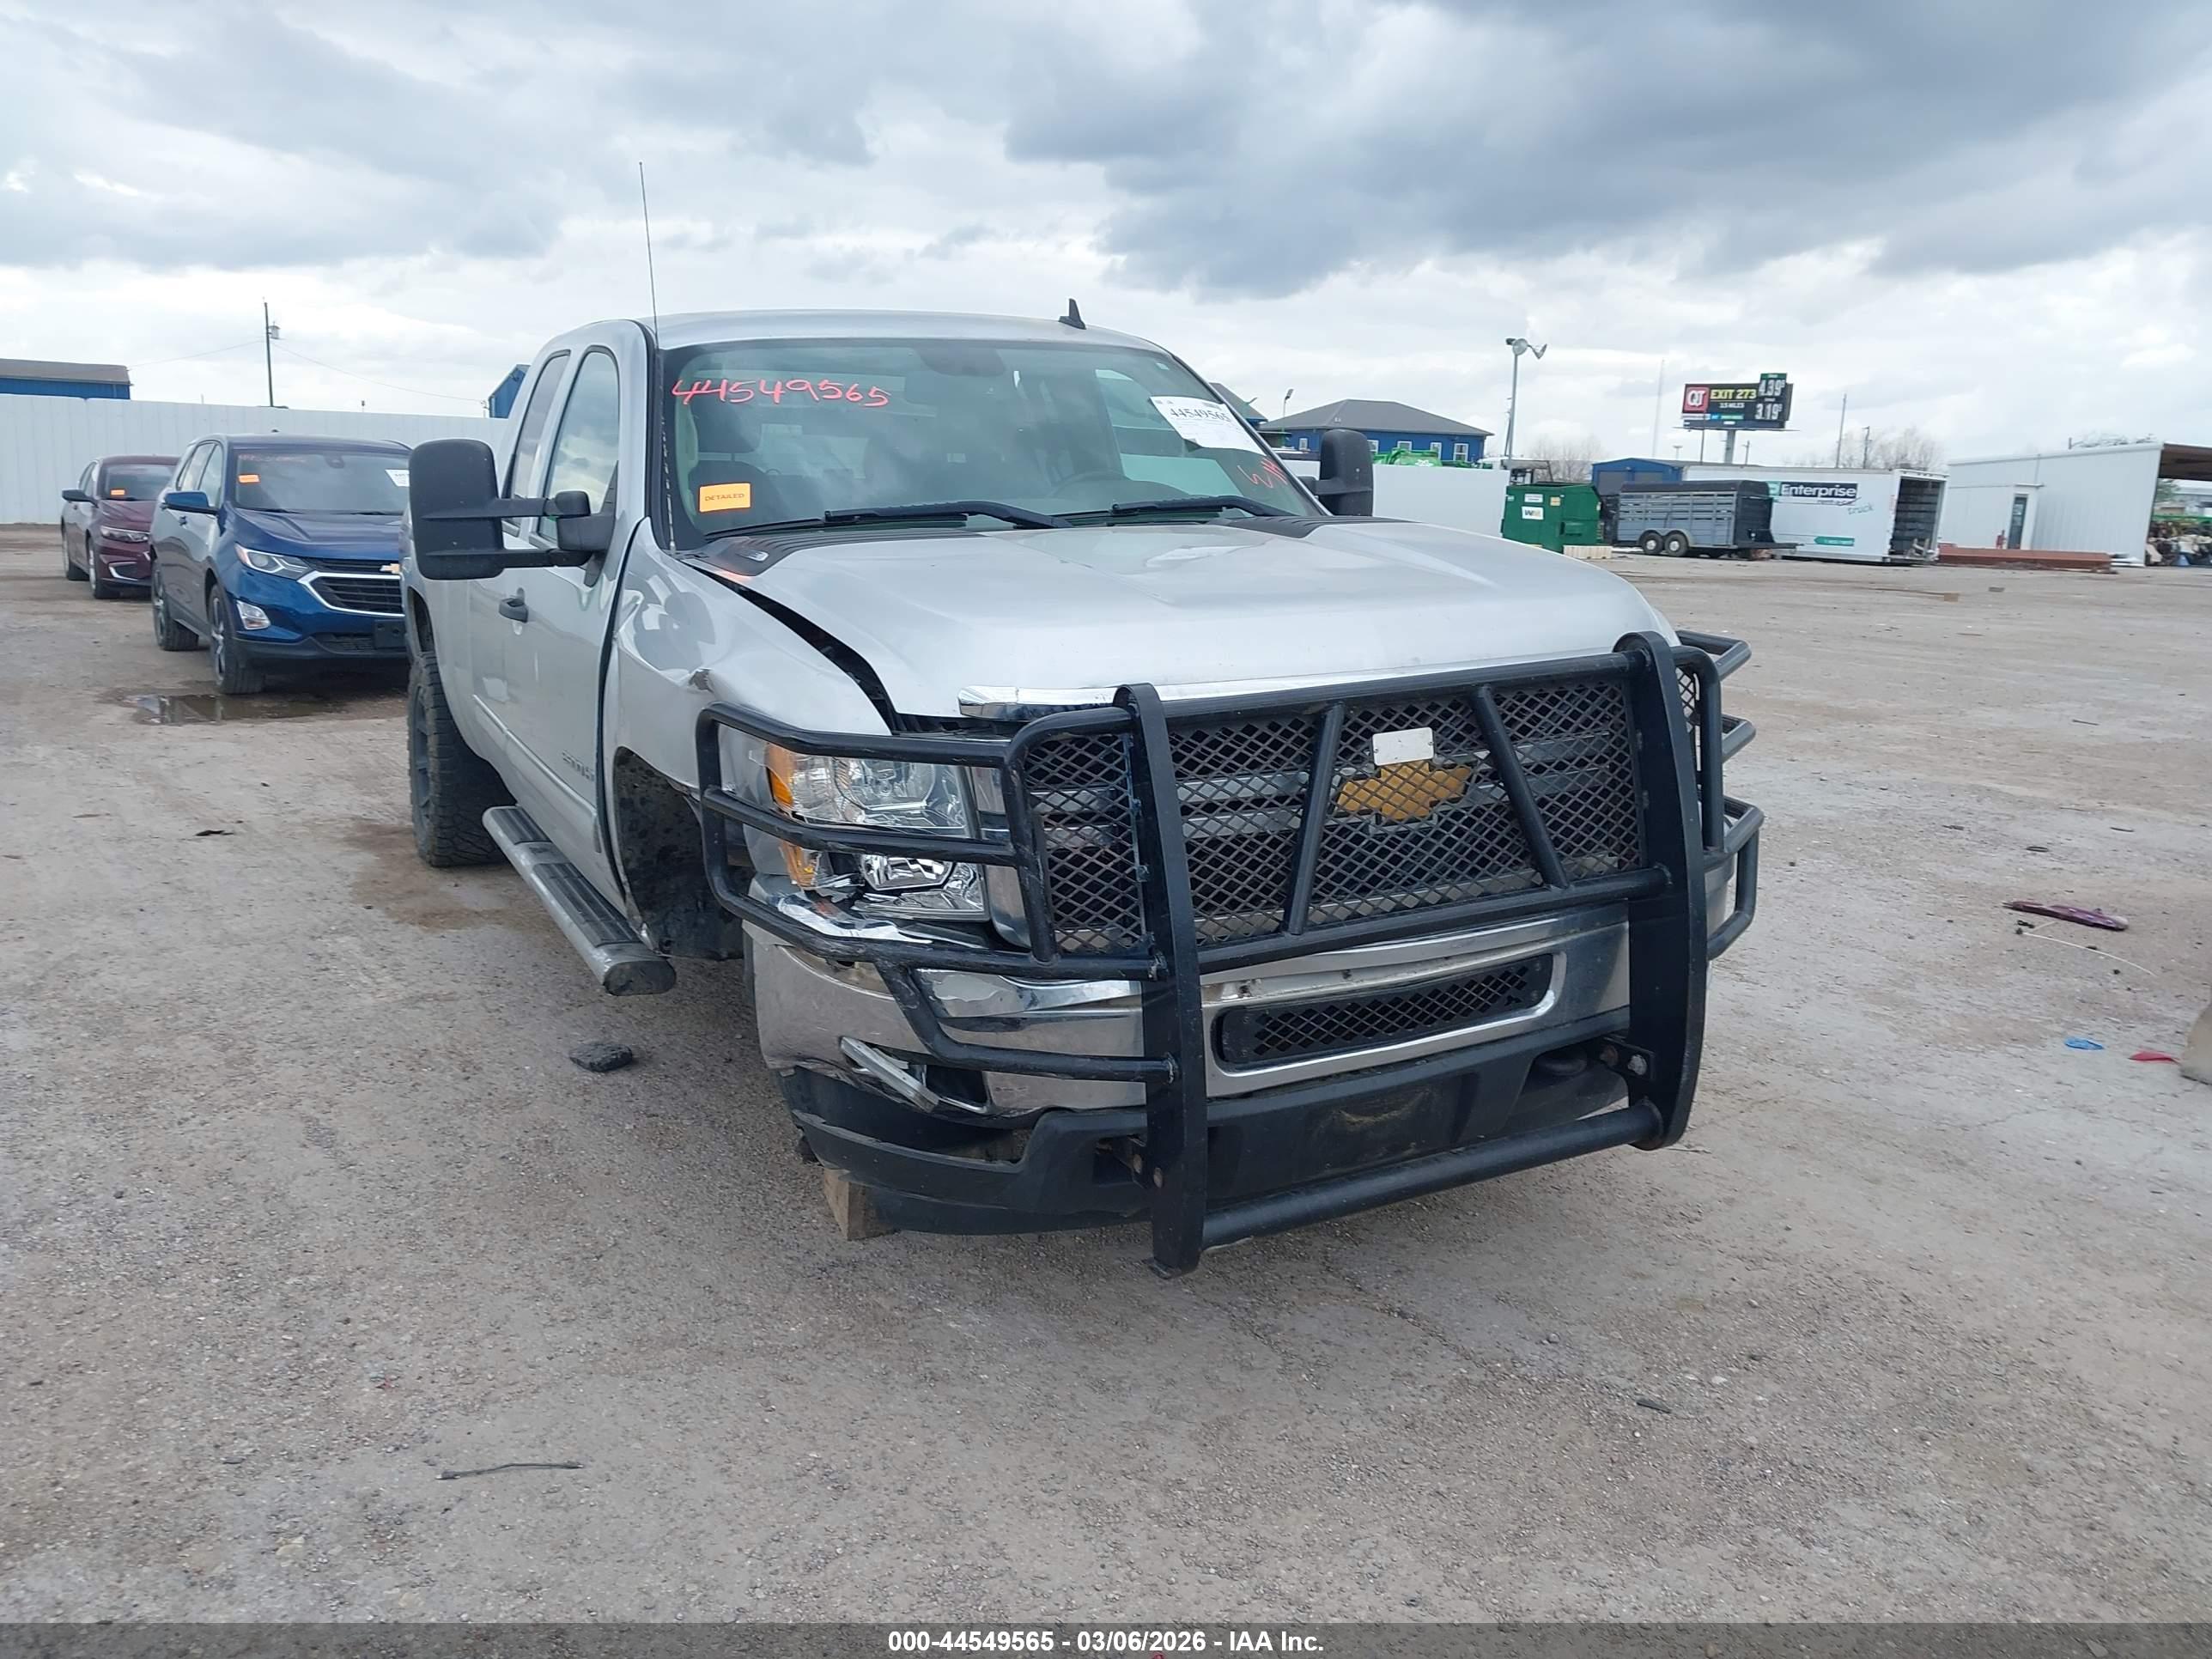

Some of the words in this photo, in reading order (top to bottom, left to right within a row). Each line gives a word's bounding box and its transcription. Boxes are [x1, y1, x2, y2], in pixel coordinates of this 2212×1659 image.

[672, 379, 891, 406] 44549565
[1710, 389, 1735, 399] EXIT
[1735, 389, 1757, 399] 273
[1170, 408, 1231, 422] 44549565
[704, 493, 745, 501] DETAILED
[1780, 483, 1856, 497] Enterprise
